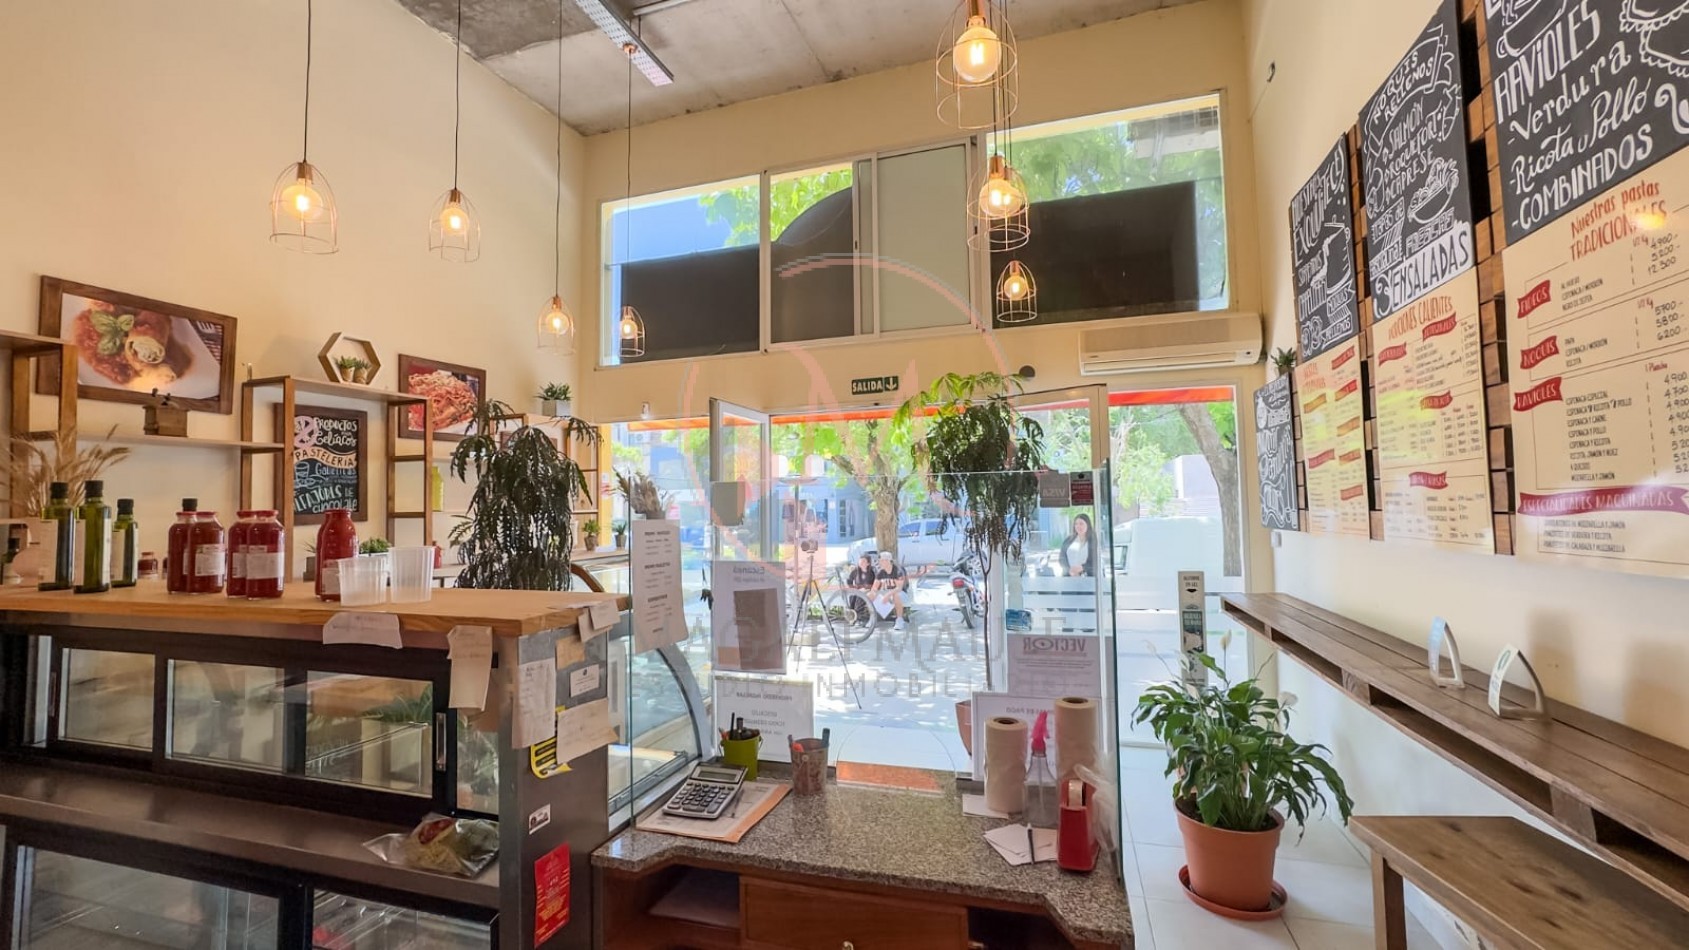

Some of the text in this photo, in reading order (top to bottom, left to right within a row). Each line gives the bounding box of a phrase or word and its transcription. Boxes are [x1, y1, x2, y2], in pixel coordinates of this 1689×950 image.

[1494, 3, 1601, 125] RAVIOLES
[1571, 180, 1661, 237] Nuestras pastas
[1571, 200, 1668, 262] TRADICIONES
[852, 380, 883, 393] SALIDA
[313, 417, 357, 432] PRODUCTOS
[294, 485, 342, 512] LFAJORES
